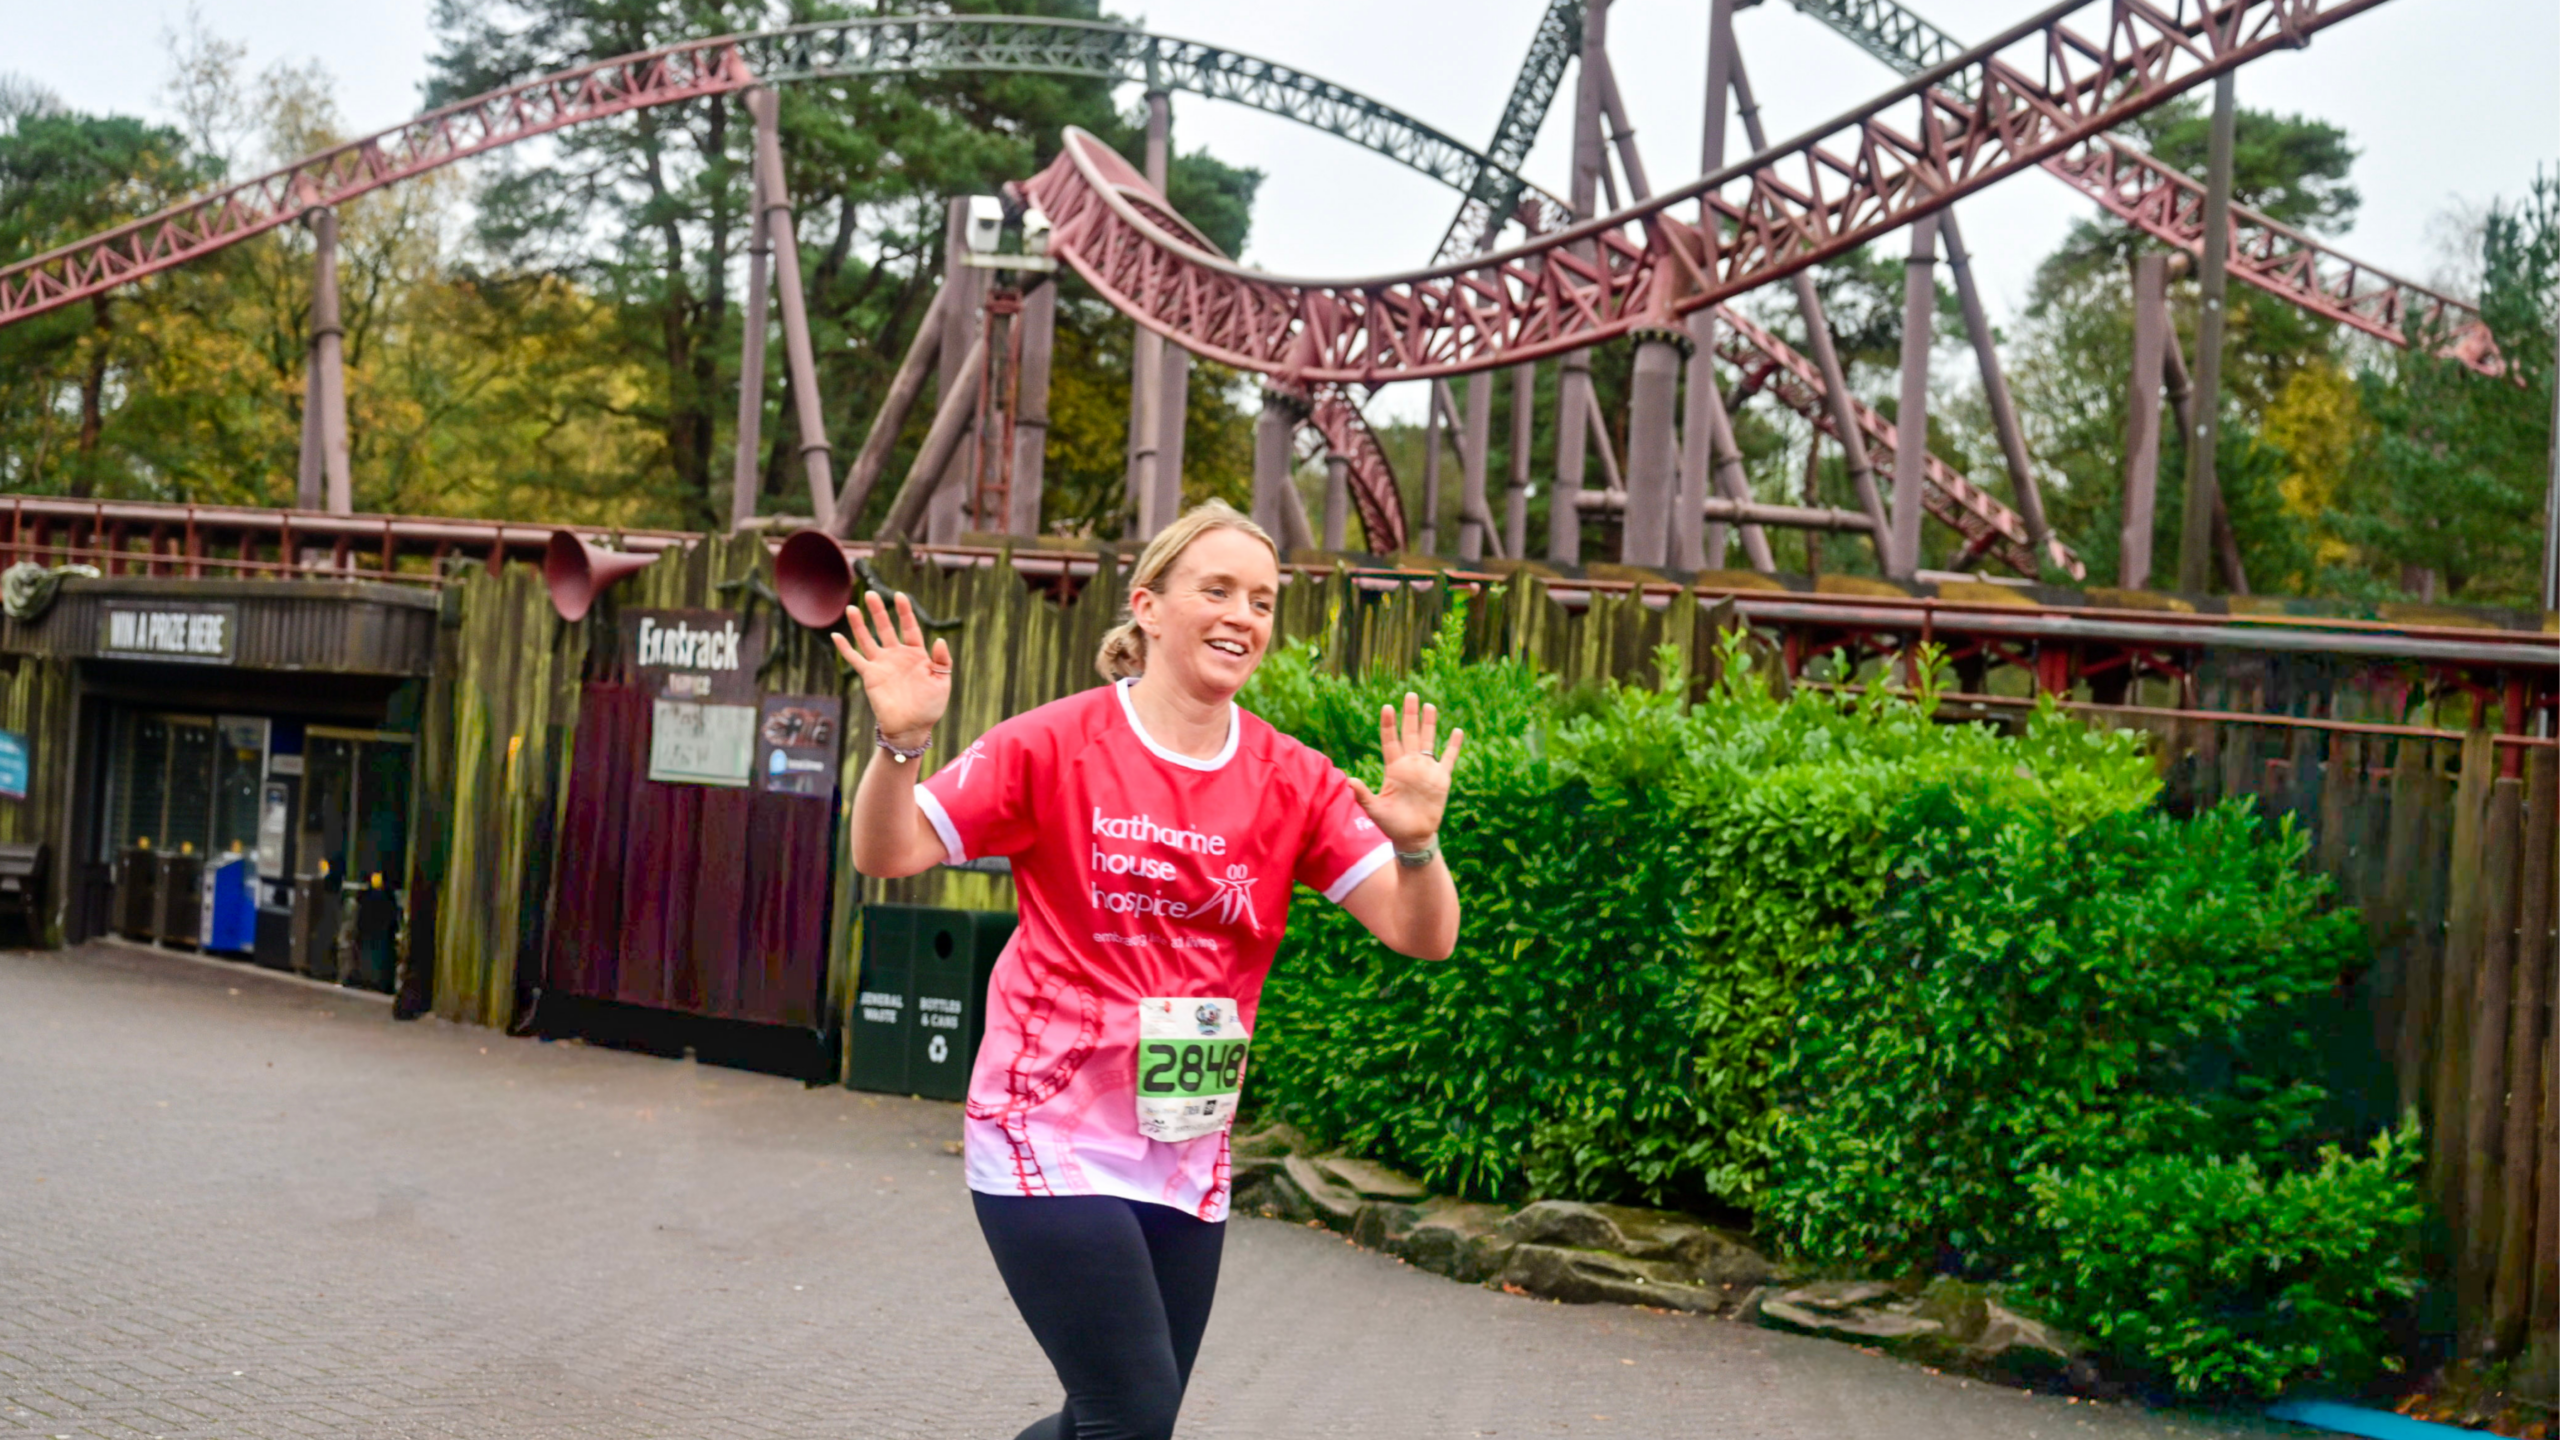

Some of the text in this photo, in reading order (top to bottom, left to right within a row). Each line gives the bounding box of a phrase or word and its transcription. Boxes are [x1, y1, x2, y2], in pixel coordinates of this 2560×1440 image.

[110, 611, 225, 654] WIN A PRIZE HERE
[1092, 842, 1177, 881] house
[1092, 881, 1188, 919] hospice
[863, 1007, 898, 1024] WASTE
[919, 996, 962, 1015] BOTTLES
[920, 1012, 930, 1027] &
[1143, 1043, 1246, 1093] 2848
